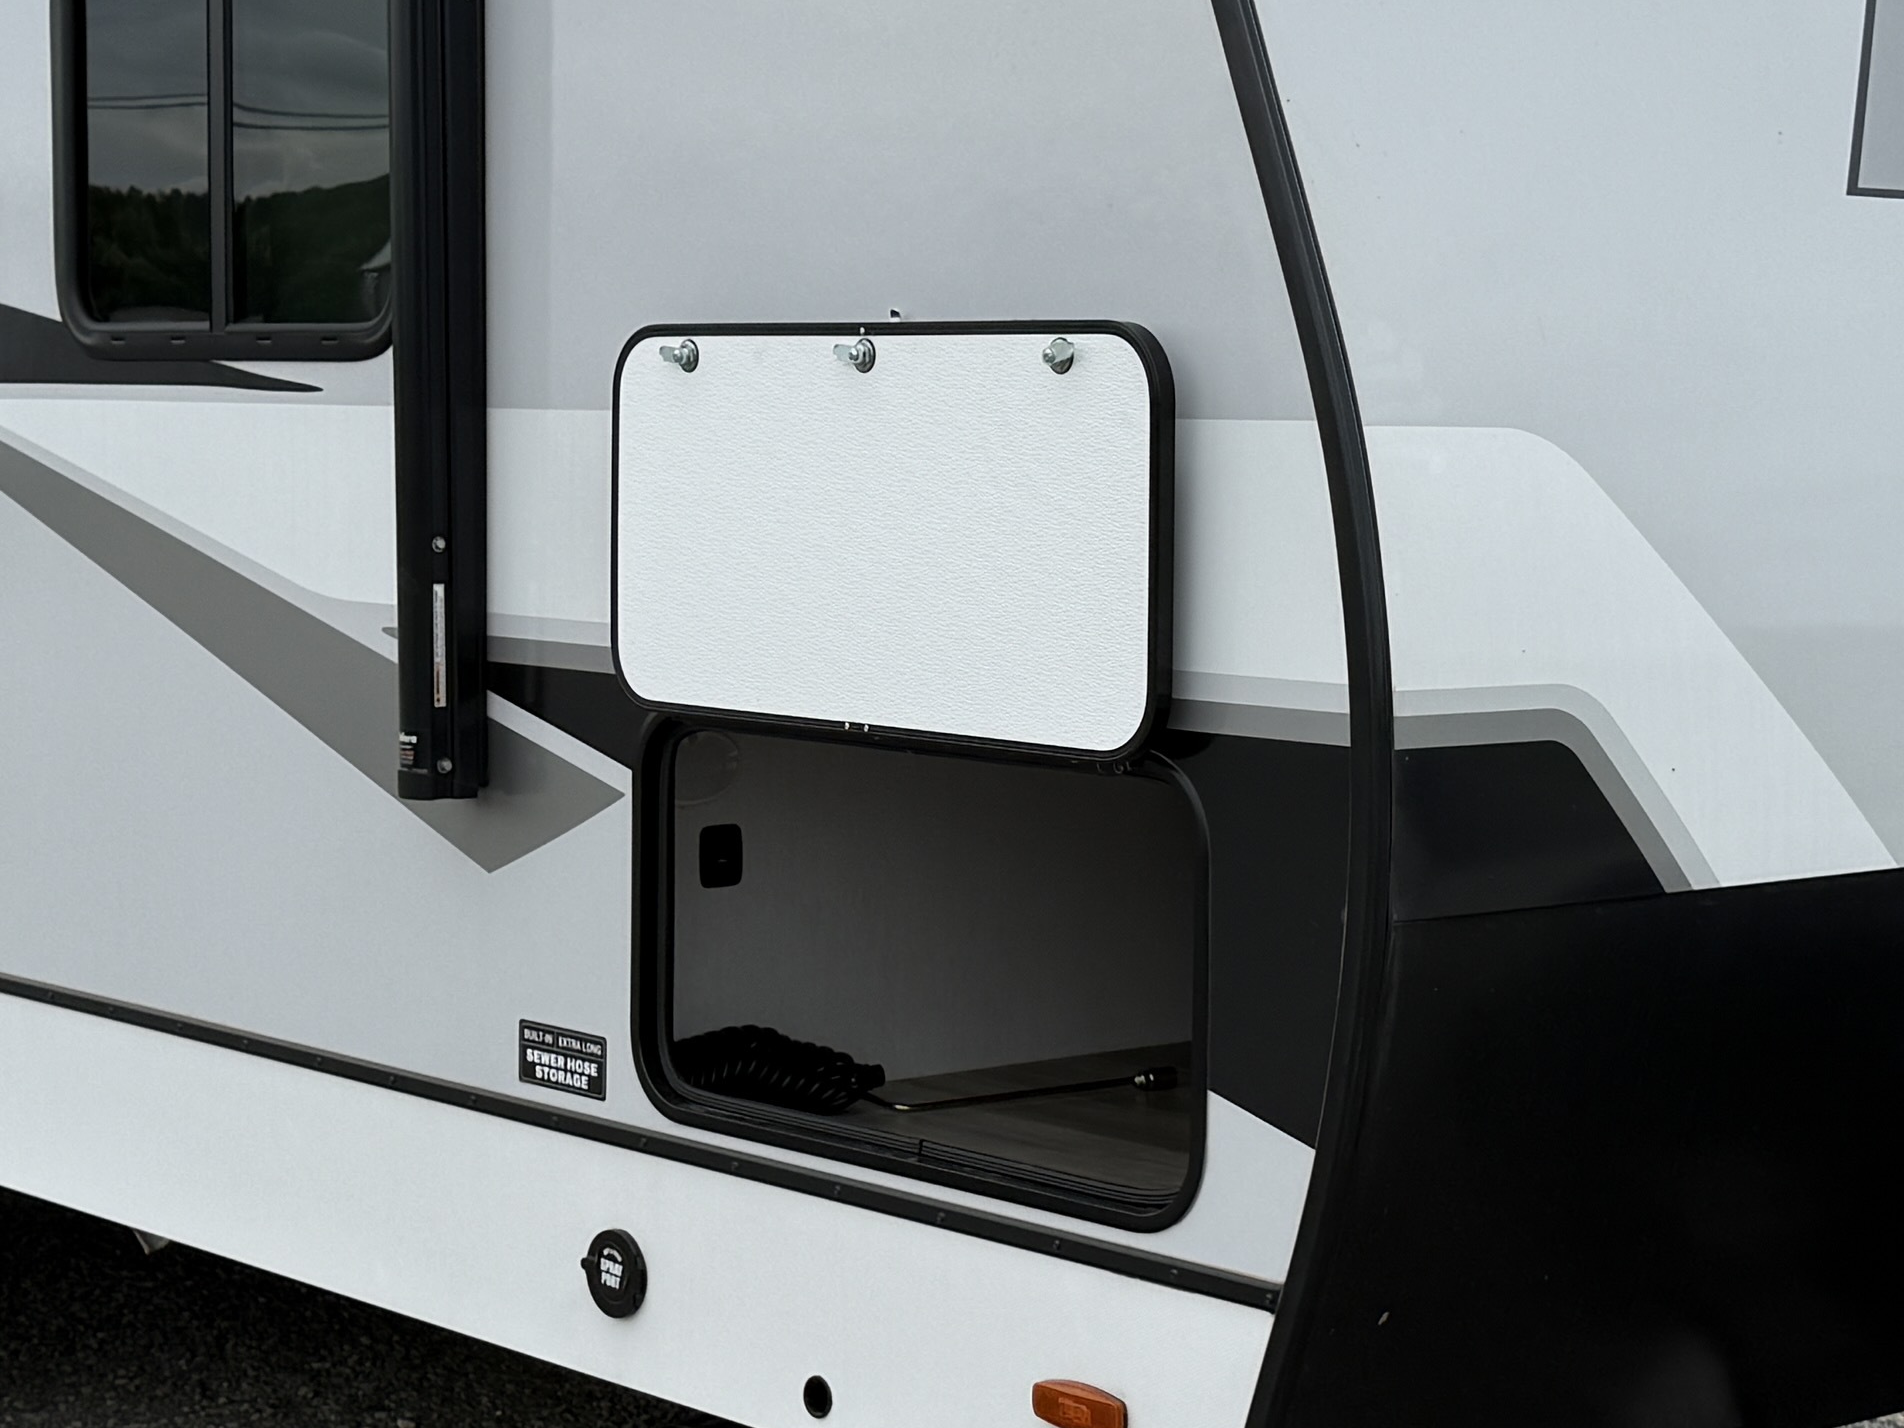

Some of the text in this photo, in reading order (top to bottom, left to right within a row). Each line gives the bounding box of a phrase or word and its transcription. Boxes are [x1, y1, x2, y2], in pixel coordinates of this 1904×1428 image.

[559, 1036, 581, 1051] EXTRA
[582, 1041, 602, 1056] LONG
[526, 1049, 598, 1077] SEWER HOSE
[536, 1066, 589, 1089] STORAGE
[600, 1258, 623, 1276] SPRAY
[601, 1272, 620, 1289] PORT
